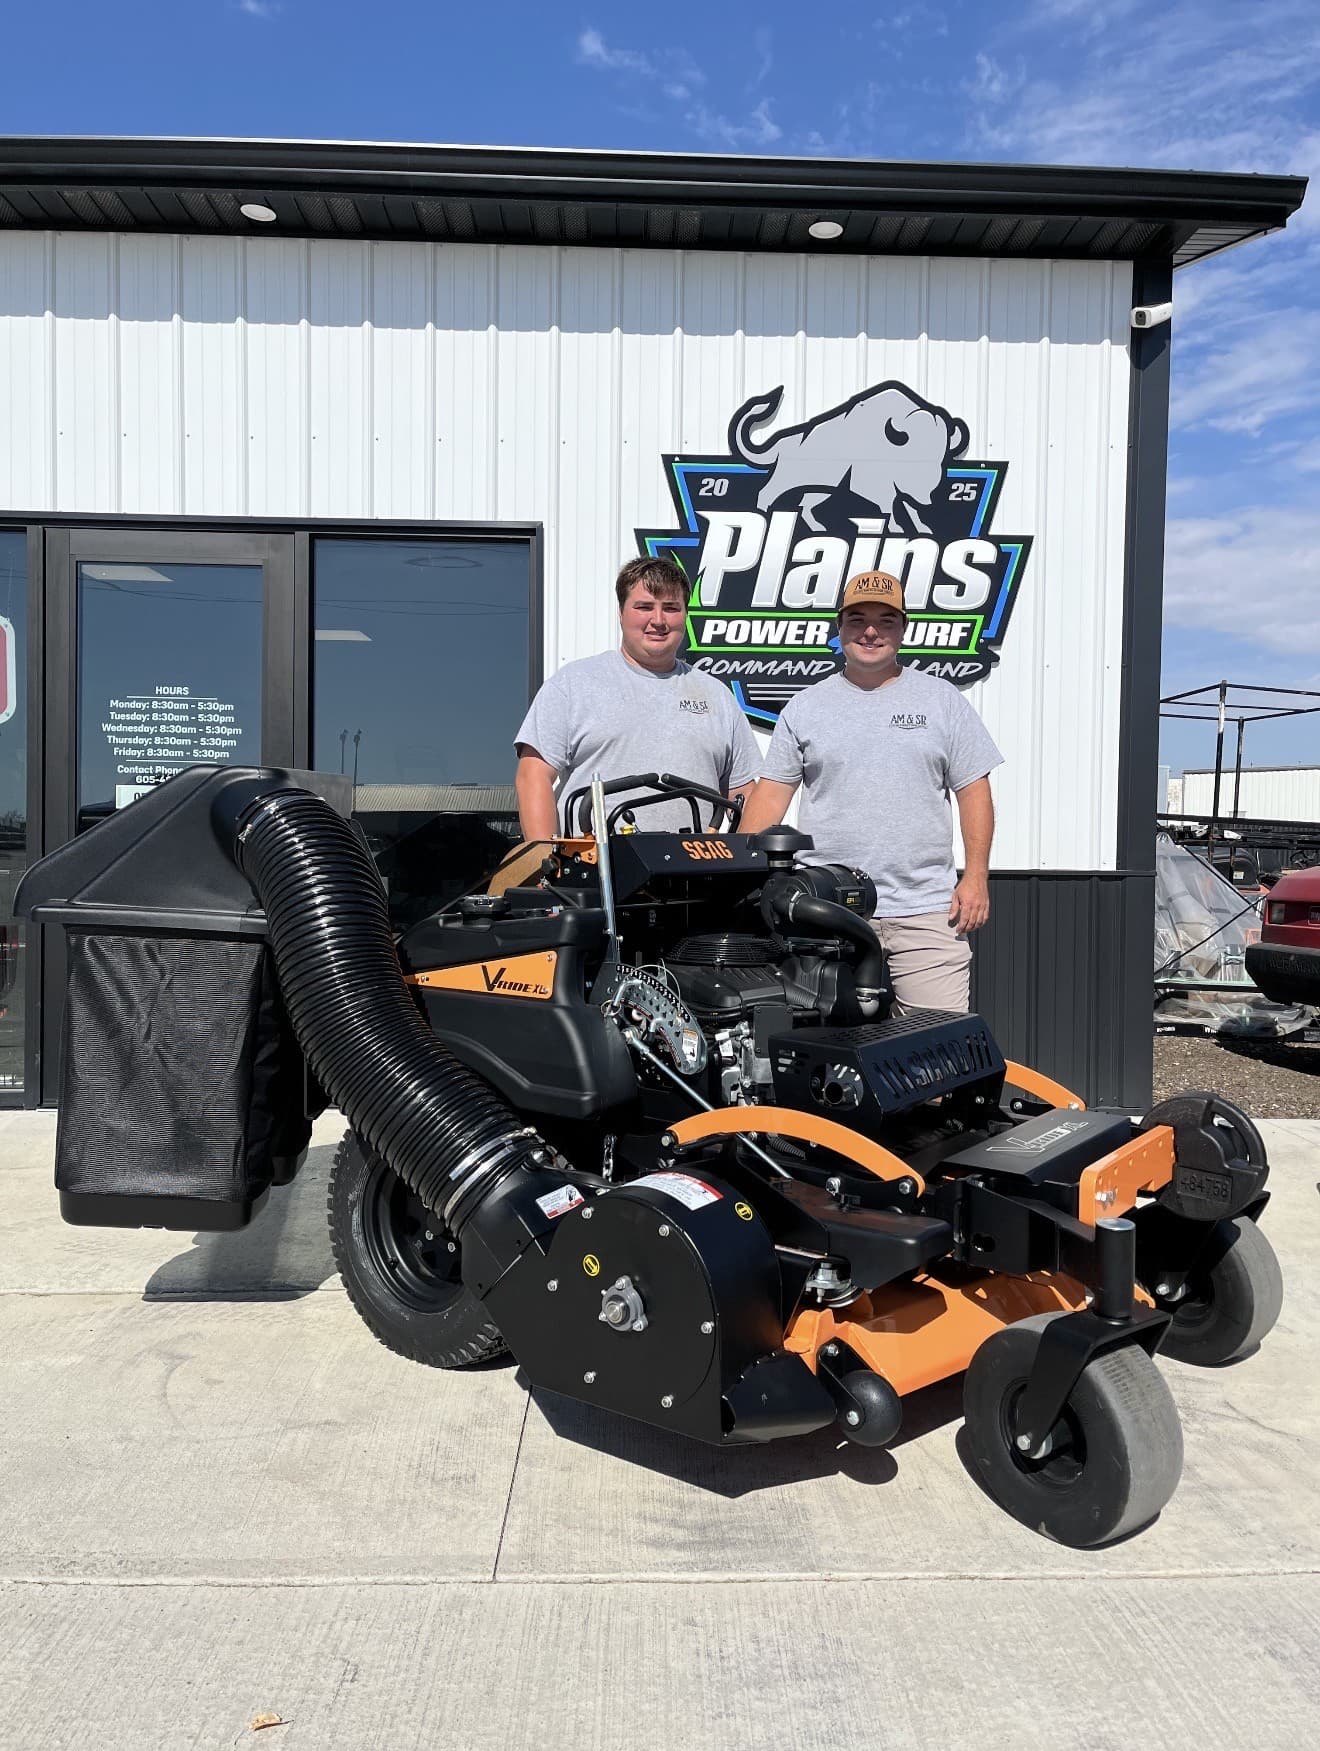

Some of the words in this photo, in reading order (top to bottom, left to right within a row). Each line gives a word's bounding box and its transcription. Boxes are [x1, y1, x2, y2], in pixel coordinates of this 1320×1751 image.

[699, 478, 729, 497] 20
[948, 483, 978, 502] 25
[695, 510, 998, 611] Plains
[855, 578, 870, 590] AM
[872, 577, 880, 587] &
[882, 578, 893, 591] SR
[701, 619, 830, 645] POWER
[901, 622, 972, 646] URF
[691, 656, 836, 676] COMMAND
[155, 686, 190, 695] HOURS
[109, 700, 149, 711] Monday:
[151, 701, 189, 710] 8:30am
[198, 702, 234, 712] 5:30pm
[109, 712, 150, 722] Tuesday:
[152, 713, 189, 721] 8:30am
[198, 714, 235, 724] 5:30pm
[891, 714, 904, 724] AM
[907, 714, 914, 723] &
[916, 714, 927, 725] SR
[101, 723, 158, 734] Wednesday:
[160, 725, 197, 734] 8:30am
[206, 726, 242, 736] 5:30pm
[107, 735, 152, 746] Thursday:
[154, 737, 191, 745] 8:30am
[200, 738, 237, 748] 5:30pm
[113, 747, 145, 758] Friday:
[147, 749, 184, 757] 8:30am
[193, 750, 230, 760] 5:30pm
[117, 765, 154, 774] Contact
[682, 841, 733, 860] SCAG
